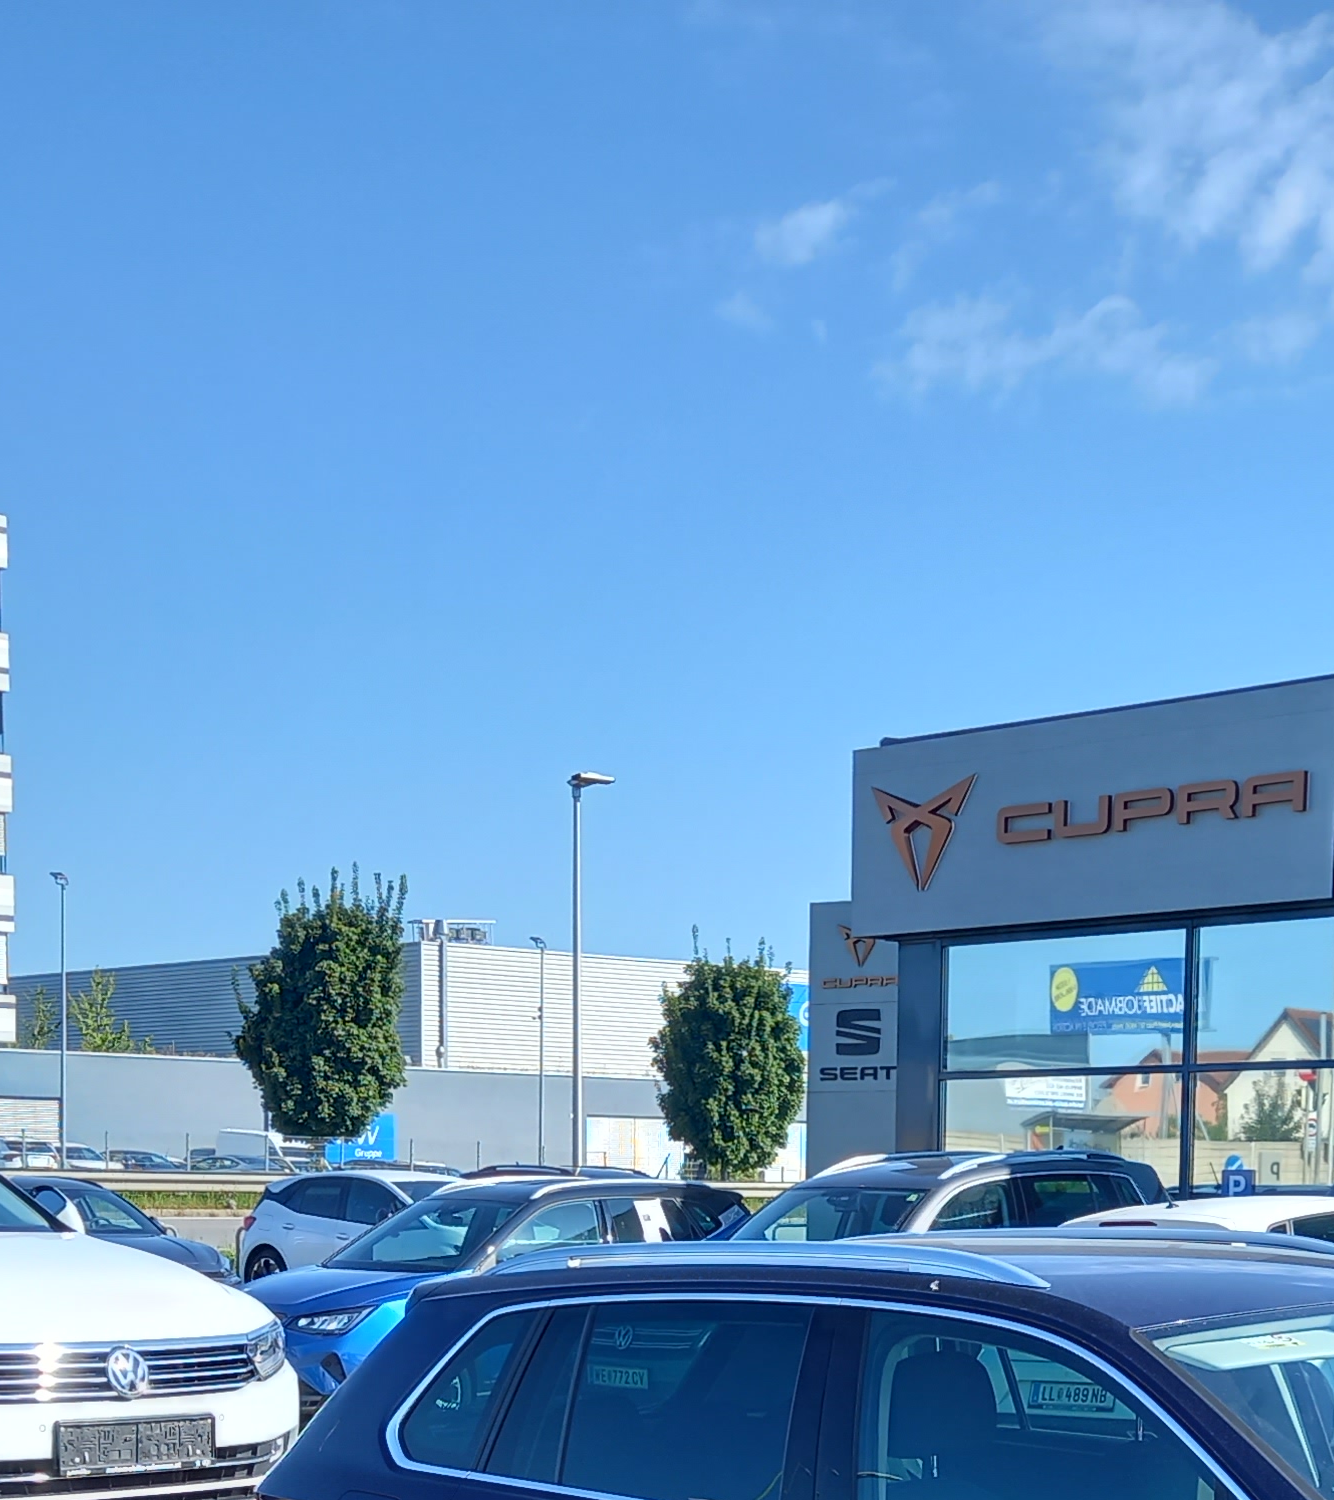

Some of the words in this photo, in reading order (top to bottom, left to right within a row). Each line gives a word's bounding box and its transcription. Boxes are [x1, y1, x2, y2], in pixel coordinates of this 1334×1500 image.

[996, 769, 1309, 845] CUPRA
[821, 976, 898, 990] CUPRA
[819, 1065, 897, 1082] SEAT
[354, 1148, 383, 1159] Gruppe
[1228, 1173, 1247, 1196] P
